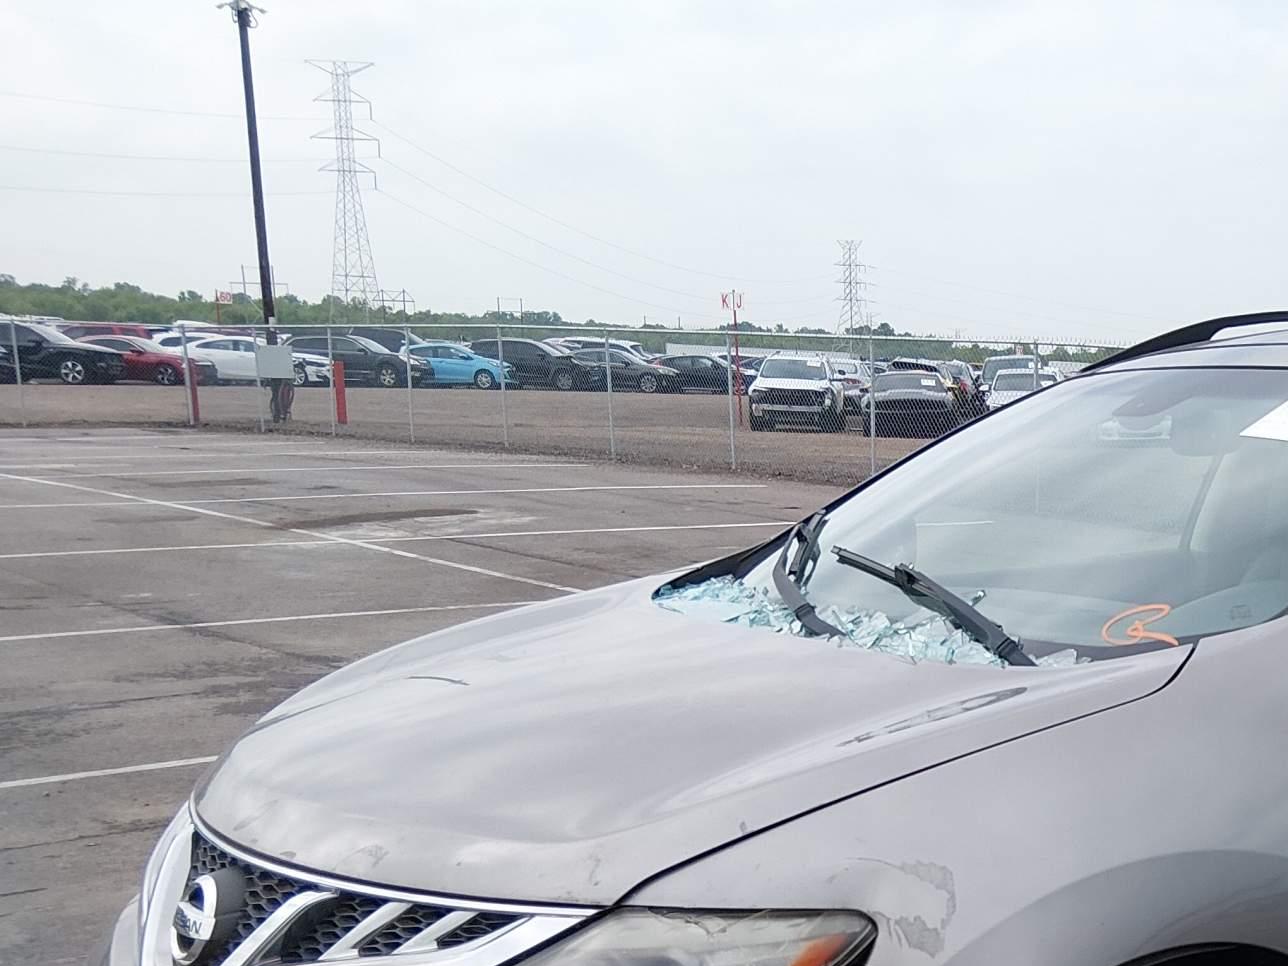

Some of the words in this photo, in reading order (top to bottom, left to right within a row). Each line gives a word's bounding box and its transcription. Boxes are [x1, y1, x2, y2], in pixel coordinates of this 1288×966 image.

[220, 291, 232, 302] 60
[721, 294, 729, 309] K
[736, 294, 742, 309] J
